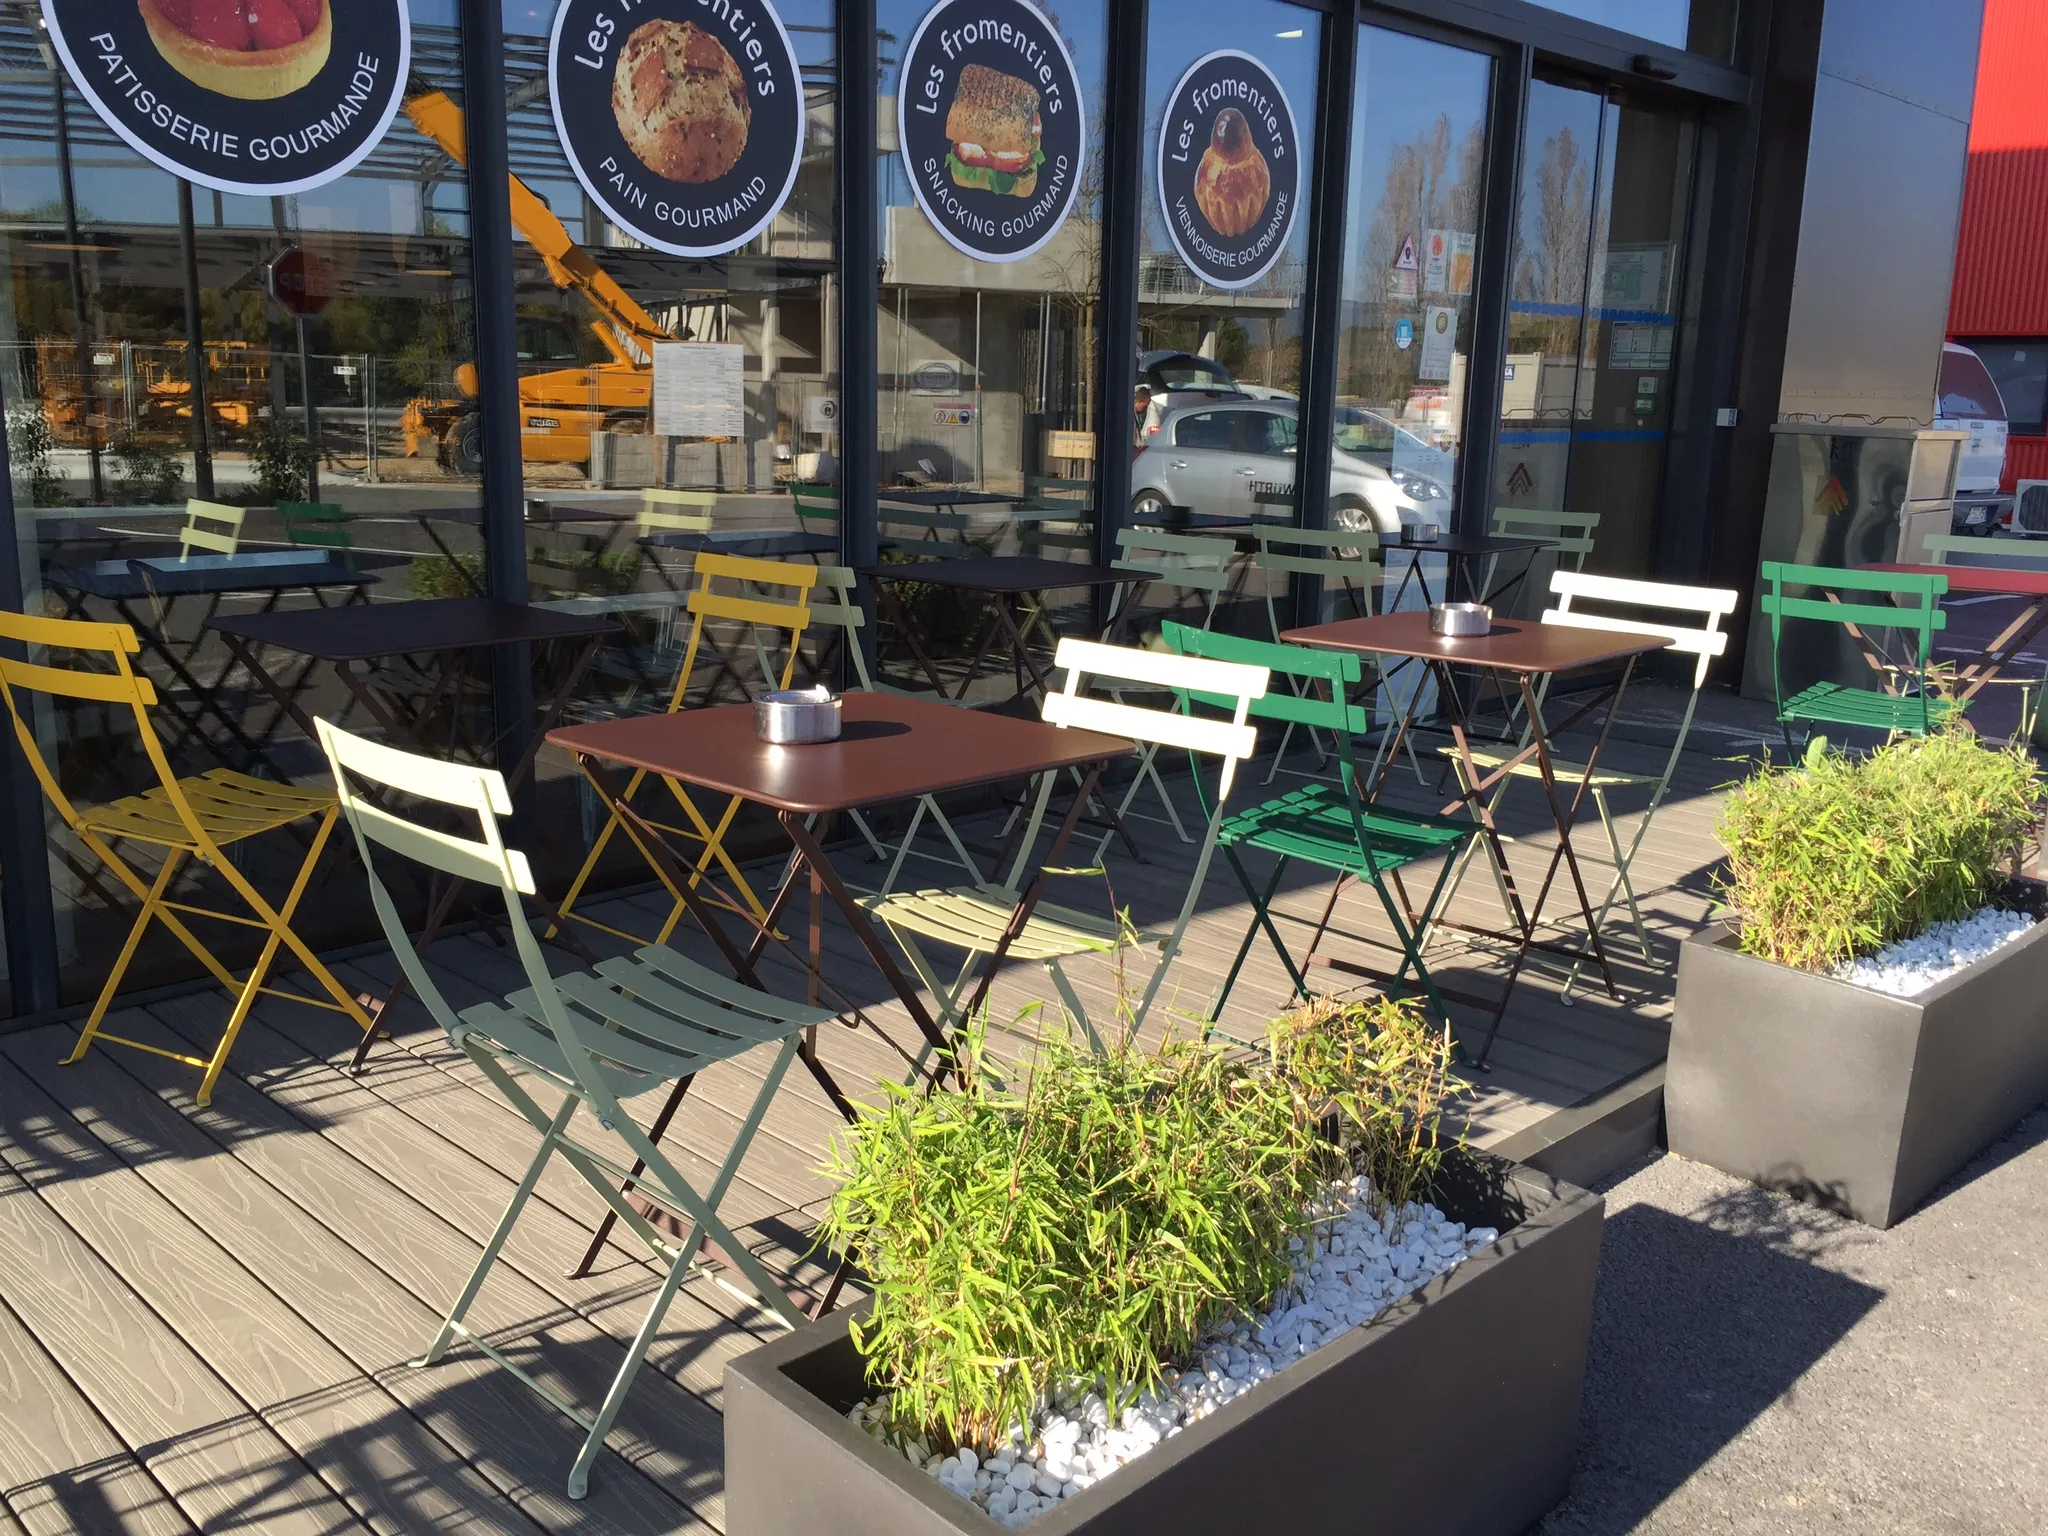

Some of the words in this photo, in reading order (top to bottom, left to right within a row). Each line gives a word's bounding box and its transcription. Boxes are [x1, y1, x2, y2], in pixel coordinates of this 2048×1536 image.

[574, 13, 615, 70] Les
[618, 0, 775, 97] ntiers
[916, 64, 944, 115] Les
[940, 19, 1063, 115] fromentiers
[90, 32, 239, 158] PATISSERIE
[249, 51, 380, 162] GOURMANDE
[1171, 118, 1195, 163] Les
[1192, 78, 1285, 159] fromentiers
[600, 156, 648, 210] PAIN
[654, 175, 767, 228] GOURMAND
[924, 156, 996, 237] SNACKING
[1001, 154, 1068, 238] GOURMAND
[1175, 195, 1237, 268] VIENNOISERIE
[1237, 190, 1288, 266] GOURMANDE
